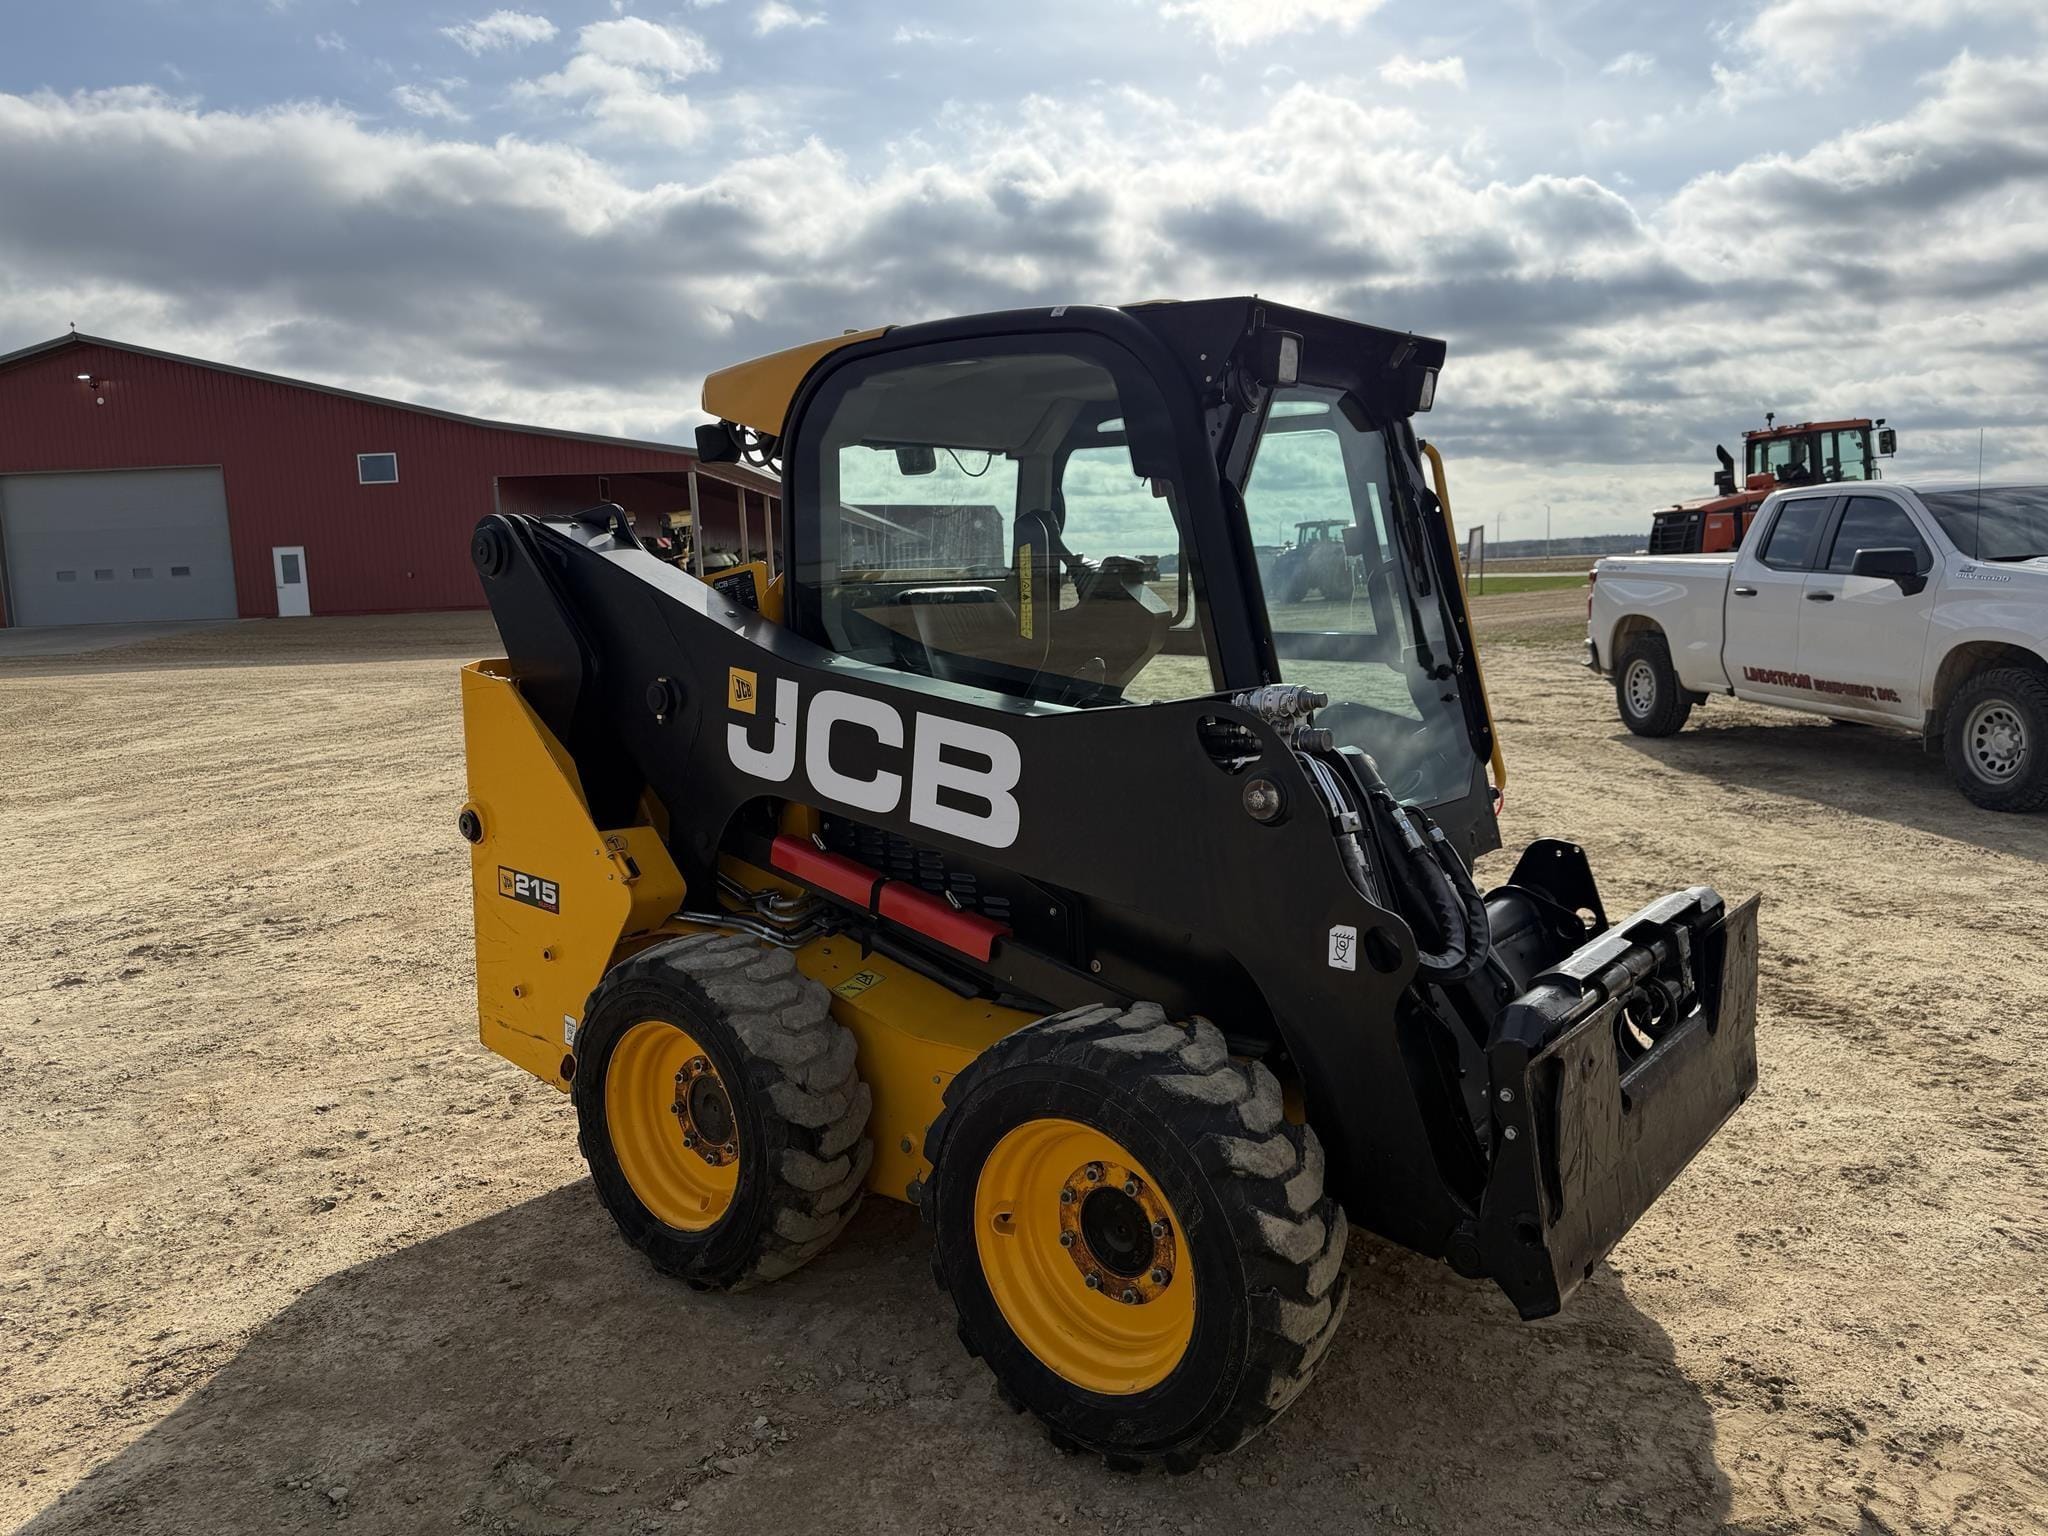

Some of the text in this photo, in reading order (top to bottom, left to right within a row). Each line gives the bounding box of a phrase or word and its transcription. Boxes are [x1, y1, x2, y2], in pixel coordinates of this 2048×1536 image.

[735, 678, 752, 698] JCB
[1743, 666, 1813, 690] LINDSTROM
[727, 677, 1021, 848] JCB
[515, 873, 557, 905] 215
